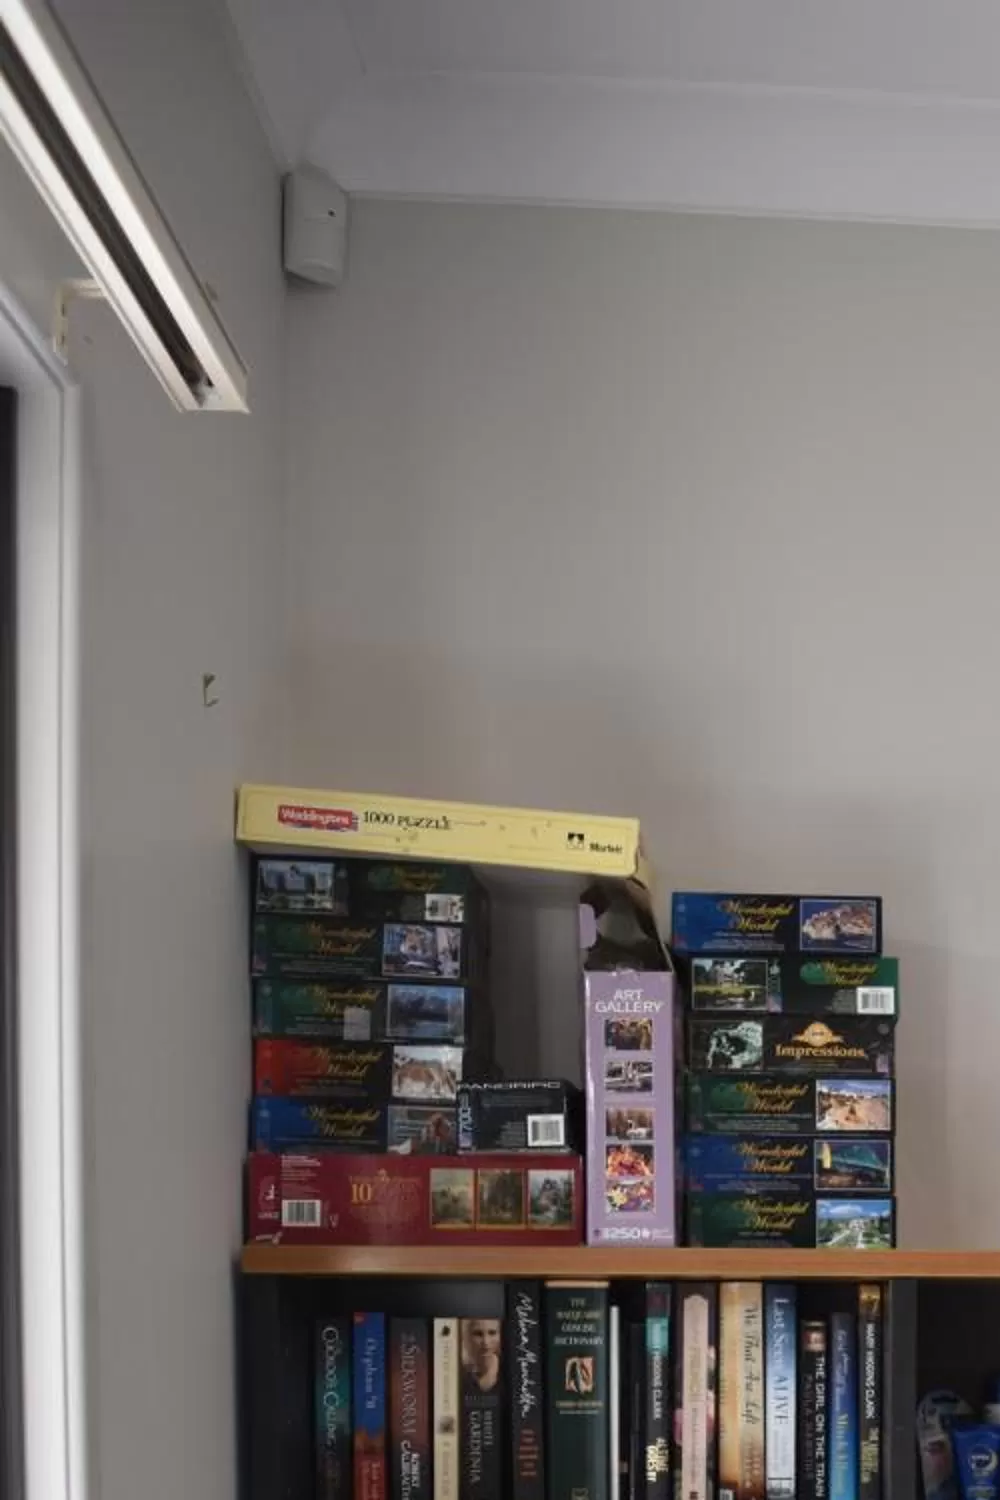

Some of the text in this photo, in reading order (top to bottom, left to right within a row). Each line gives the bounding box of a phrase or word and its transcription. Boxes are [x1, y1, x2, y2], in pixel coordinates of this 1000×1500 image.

[364, 811, 394, 824] 1000
[595, 1001, 662, 1013] GALLERY
[613, 989, 643, 1000] ART
[772, 1373, 789, 1426] ALIVE
[815, 1356, 826, 1498] THE GIRL ON THE TRAIN
[469, 1410, 481, 1484] GARDENIA
